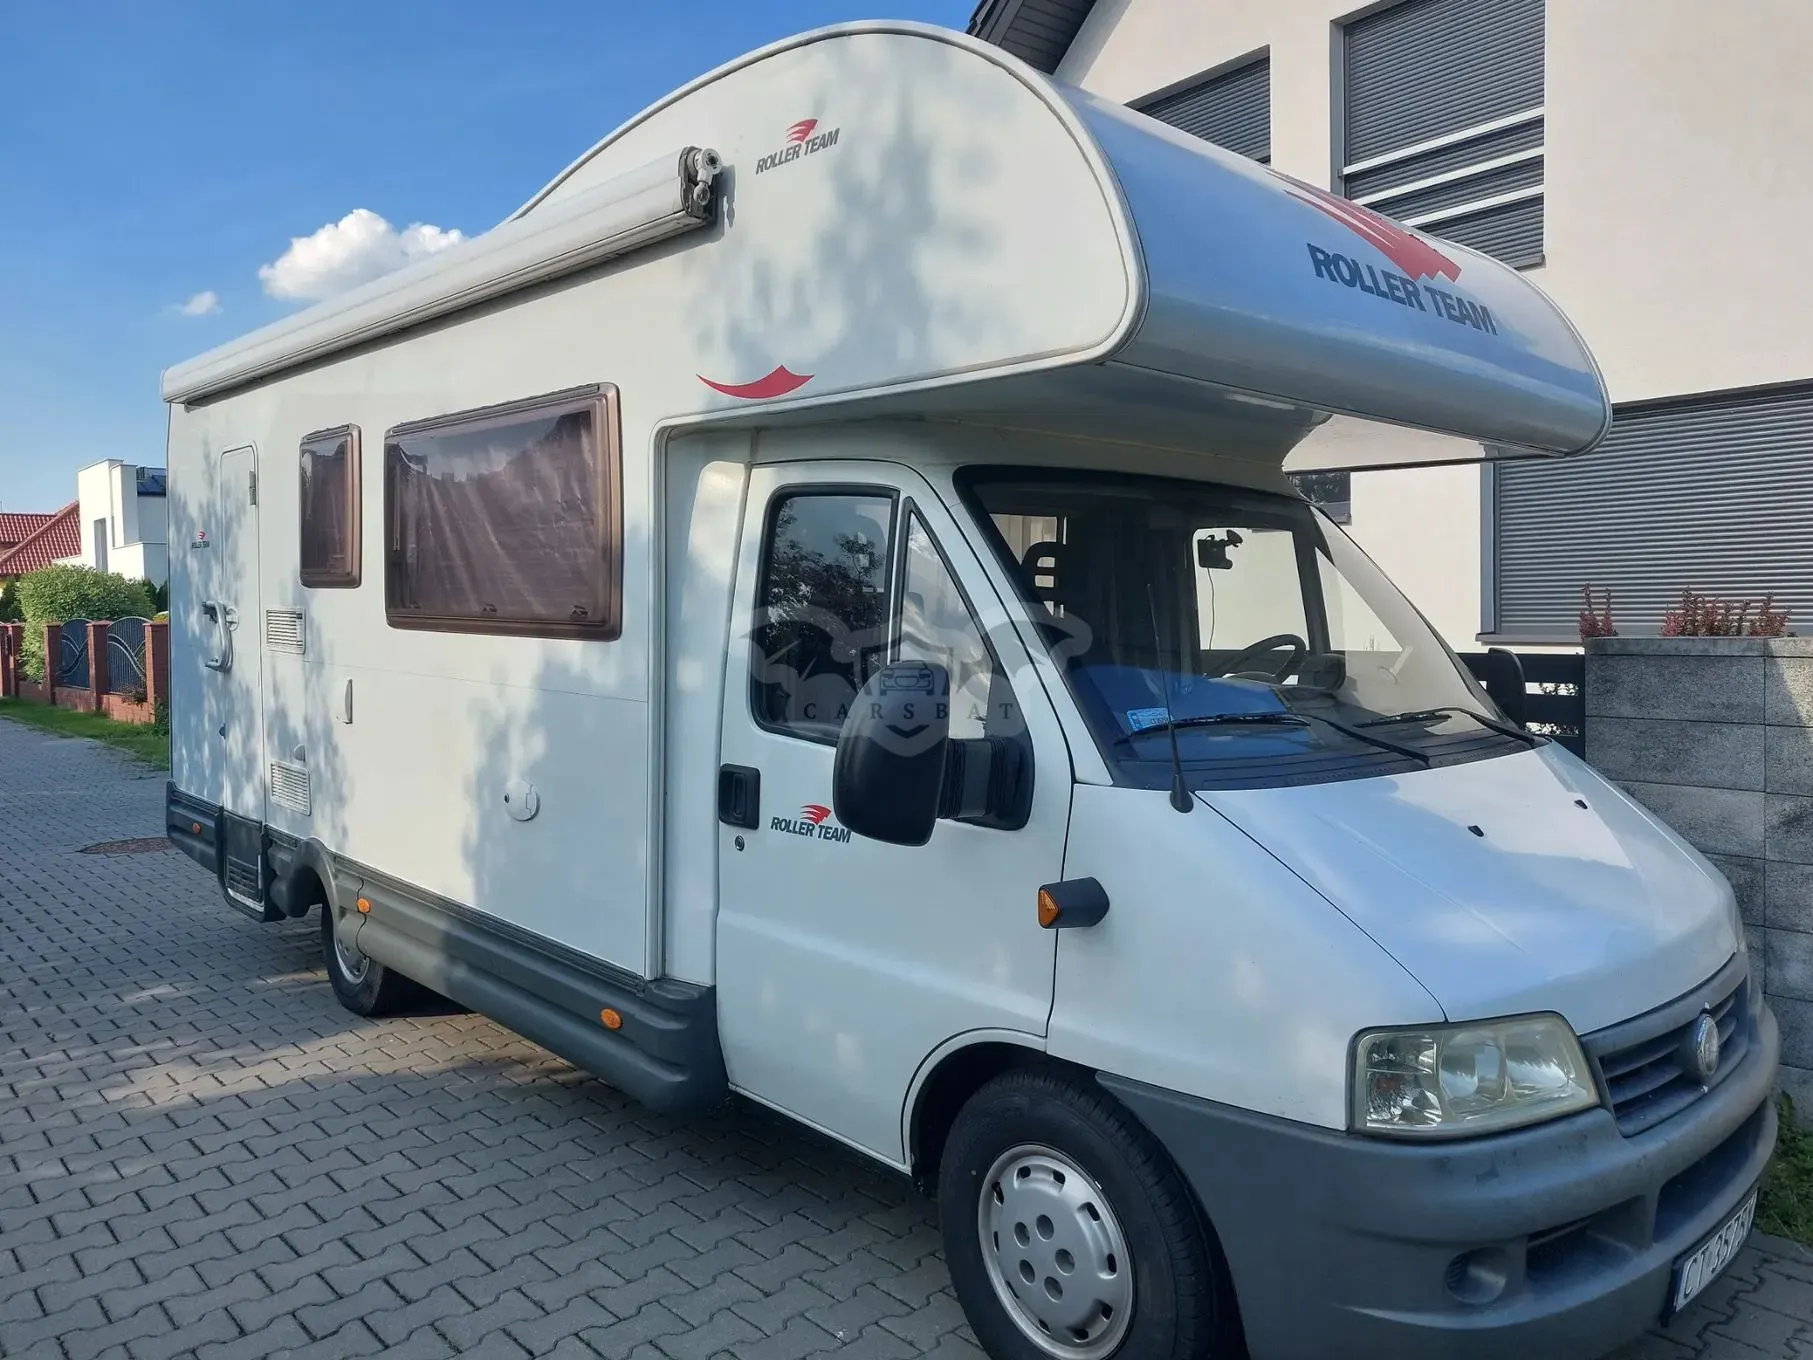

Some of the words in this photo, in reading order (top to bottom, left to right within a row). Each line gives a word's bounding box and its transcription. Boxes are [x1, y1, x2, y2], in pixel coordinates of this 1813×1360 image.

[756, 143, 802, 175] ROLLER
[804, 127, 840, 156] TEAM
[1307, 243, 1427, 312] ROLLER
[1423, 285, 1498, 336] TEAM
[770, 816, 815, 837] ROLLER
[817, 824, 852, 843] TEAM
